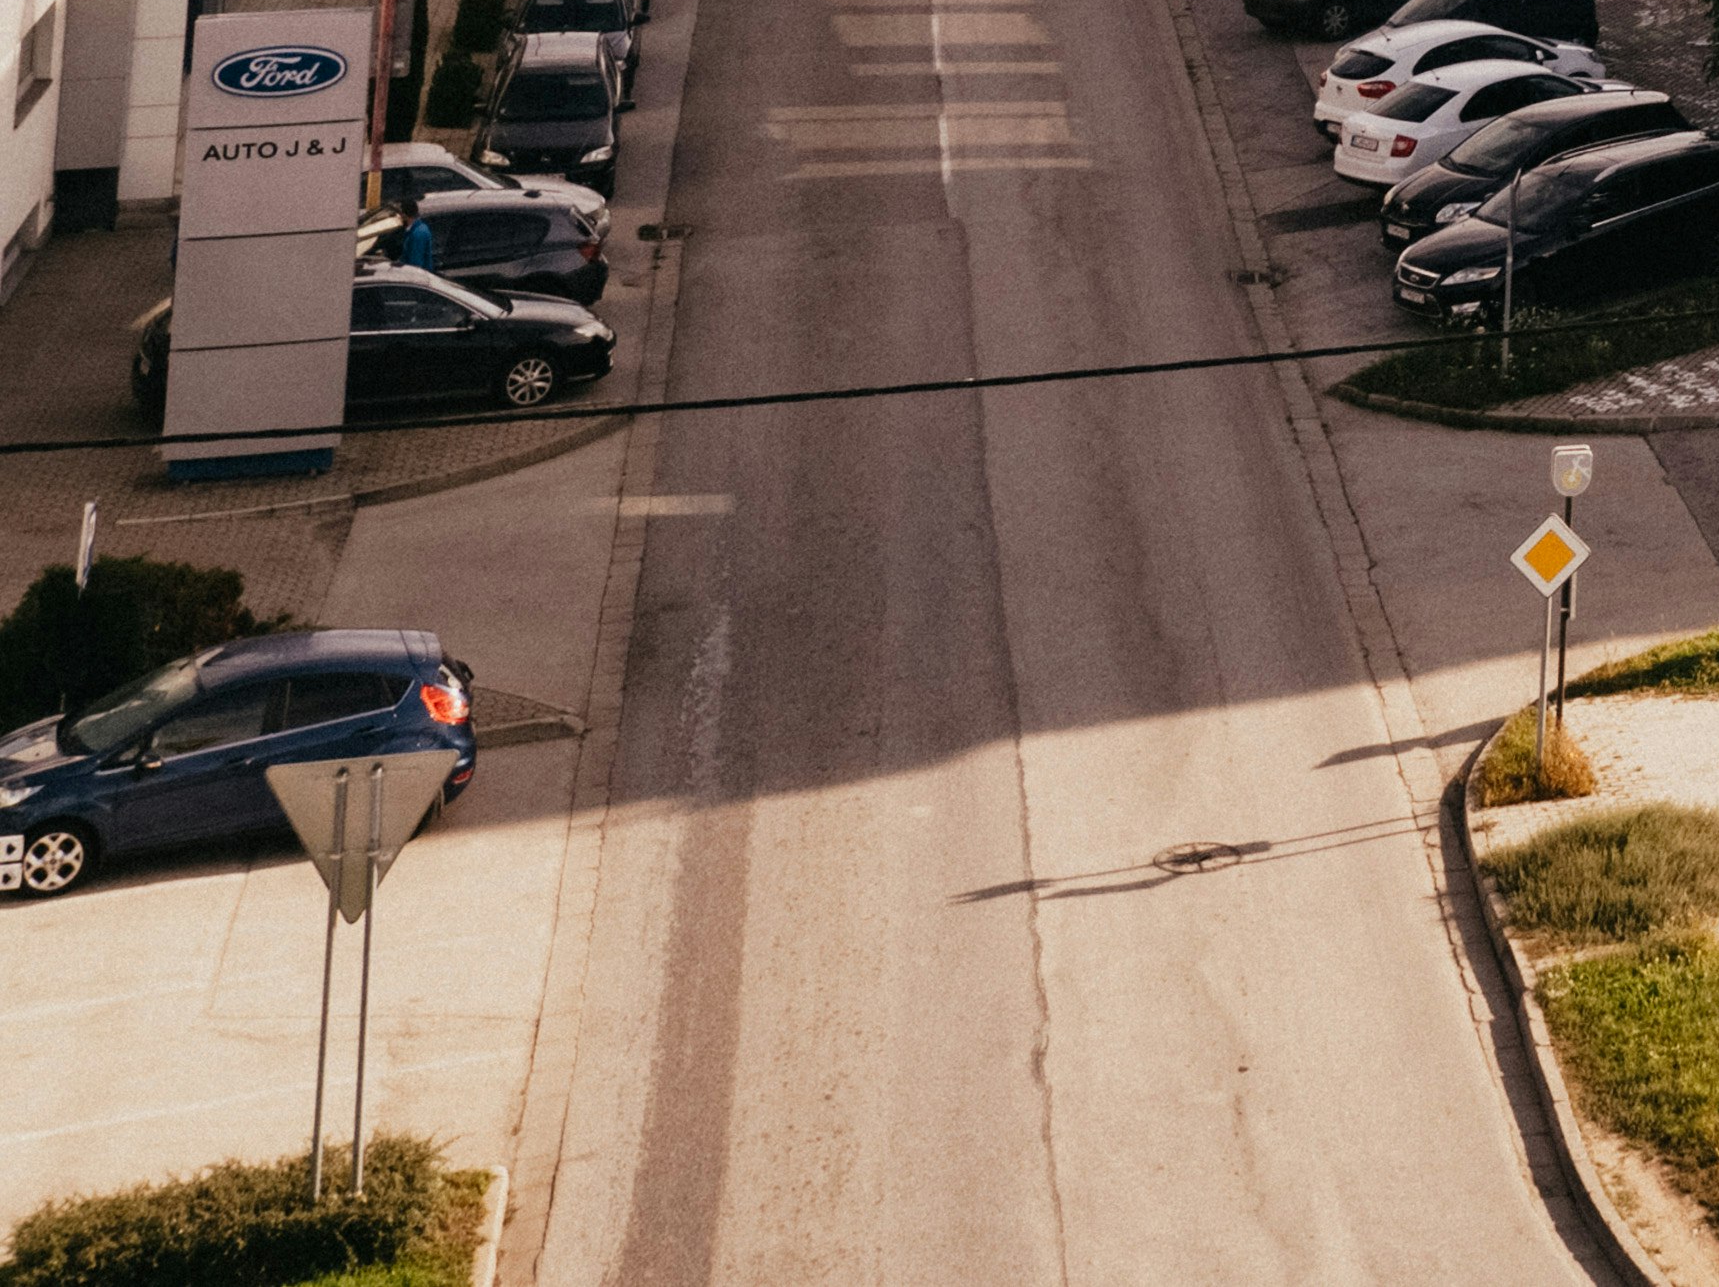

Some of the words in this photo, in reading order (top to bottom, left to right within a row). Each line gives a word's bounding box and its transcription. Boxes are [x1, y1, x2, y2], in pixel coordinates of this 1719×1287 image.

[240, 55, 321, 88] Ford
[202, 141, 279, 162] AUTO
[285, 139, 300, 157] J
[306, 138, 324, 156] &
[332, 137, 347, 154] J
